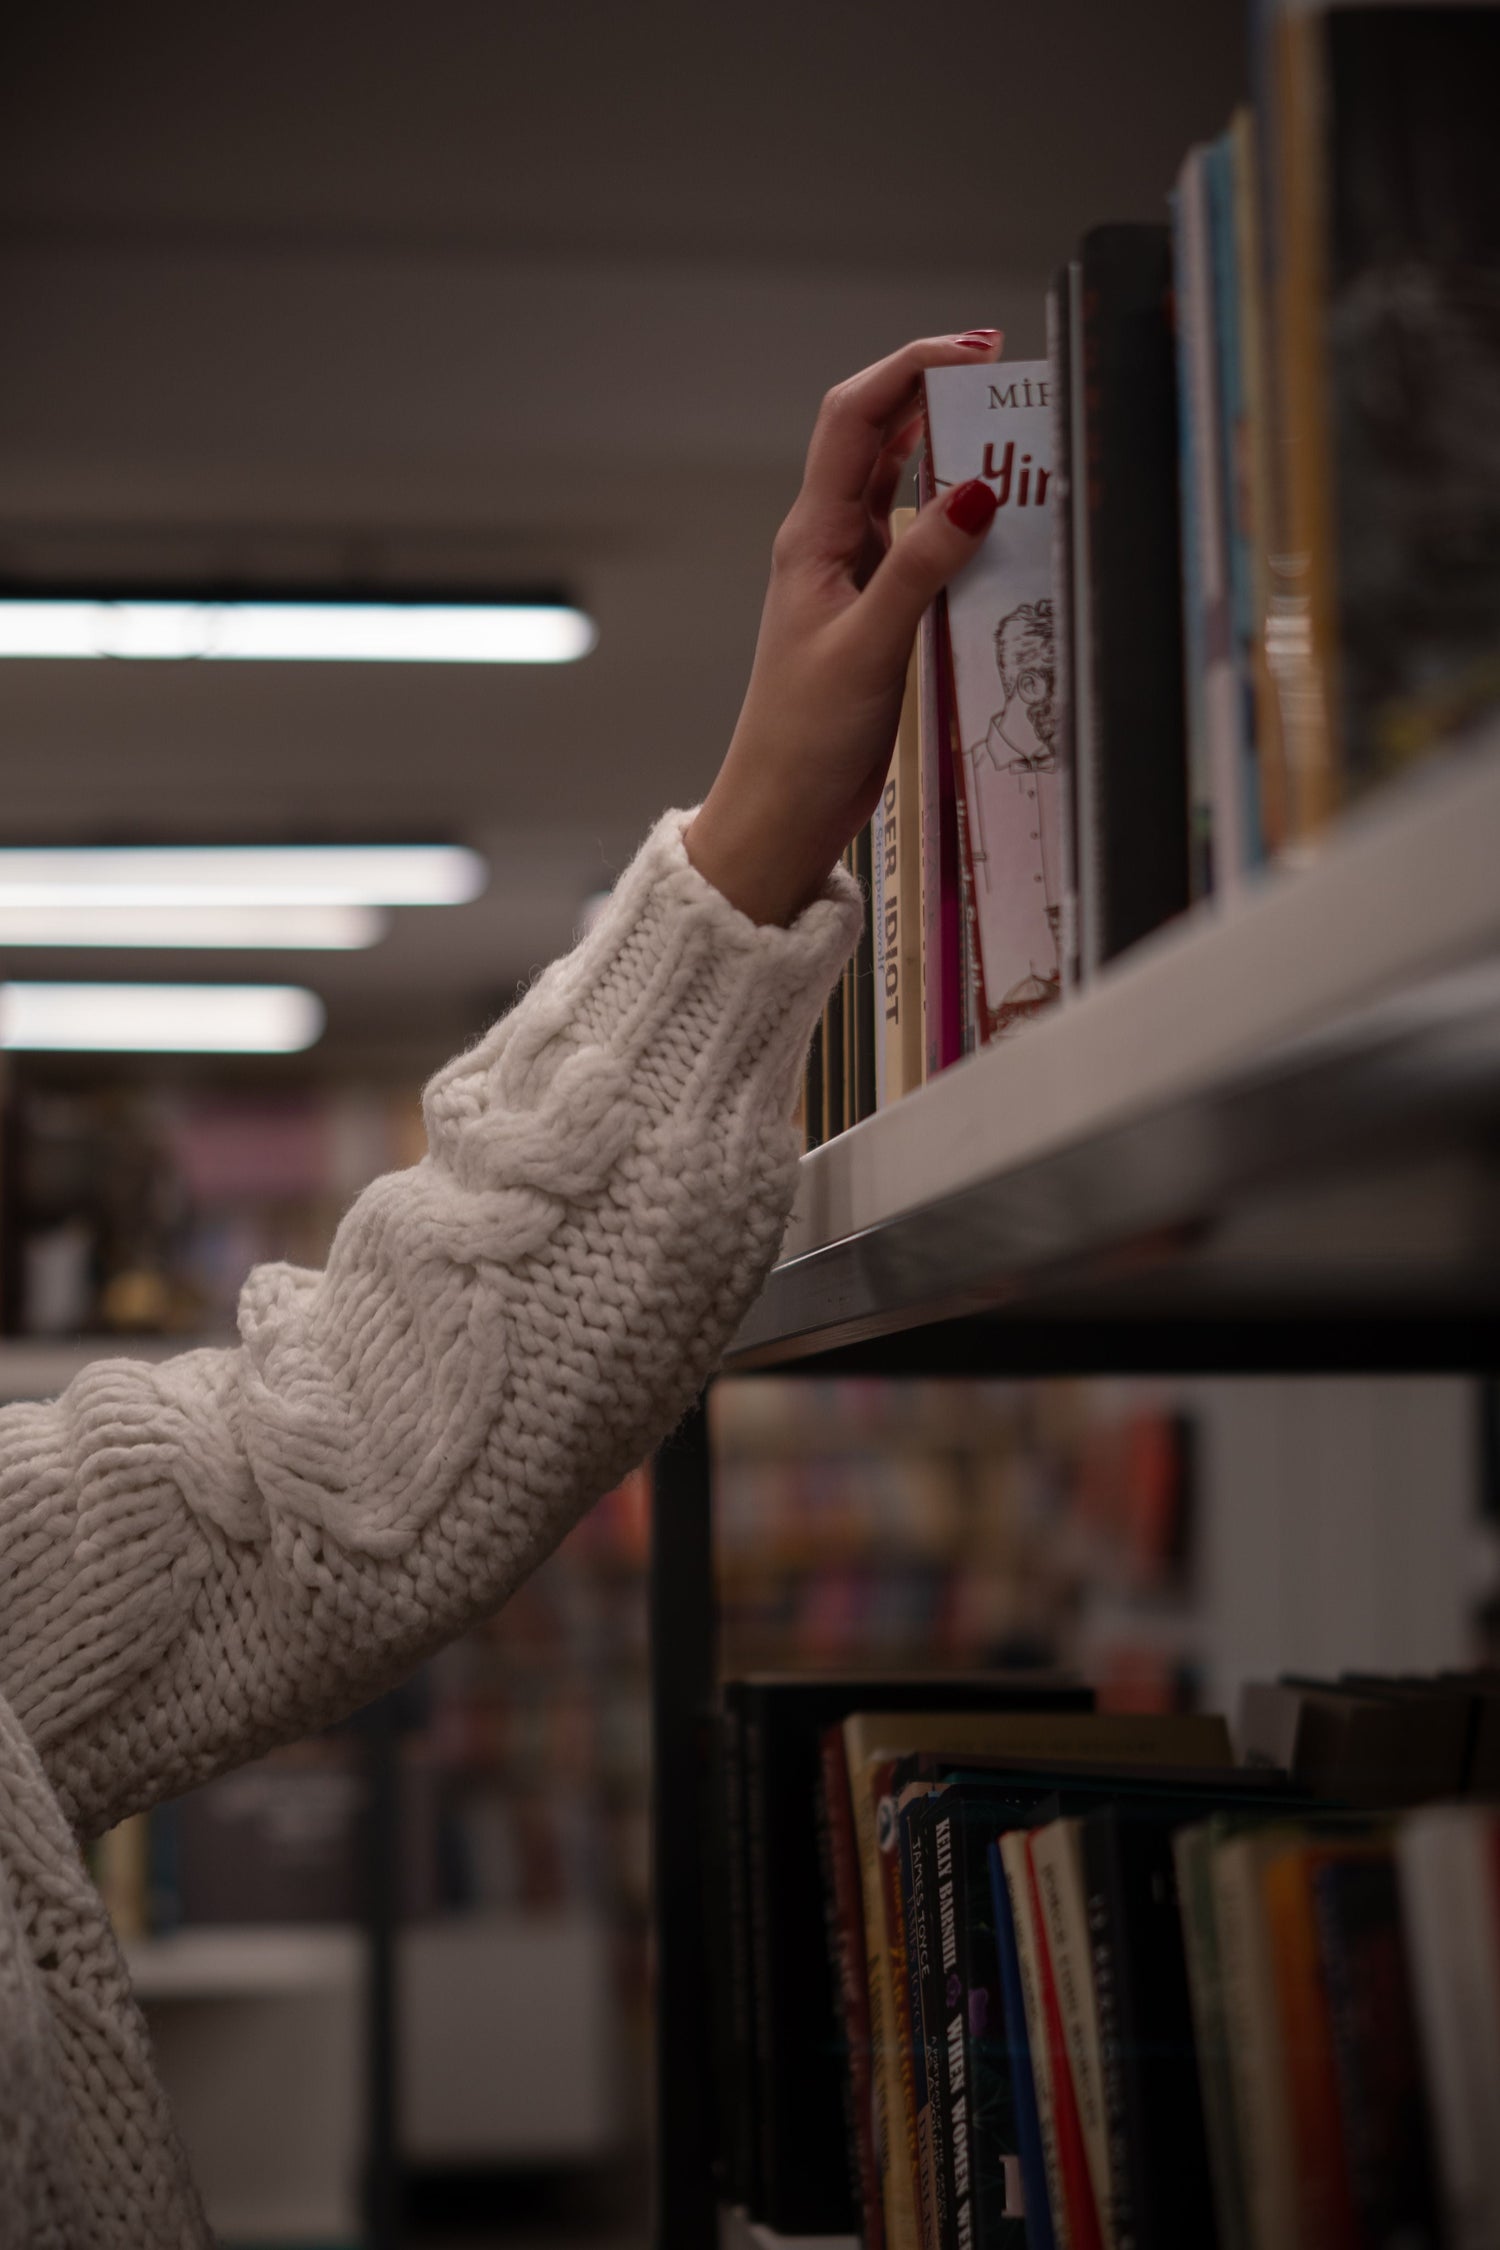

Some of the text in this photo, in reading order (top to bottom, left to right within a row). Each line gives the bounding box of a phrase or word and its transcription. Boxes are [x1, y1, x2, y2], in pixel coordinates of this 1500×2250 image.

[884, 779, 899, 1025] DER IDIOT
[935, 1816, 952, 1879] KELLY
[912, 1836, 930, 1979] JAMES JOYCE
[947, 2012, 966, 2095] WHEN
[951, 2094, 971, 2199] WOMEN
